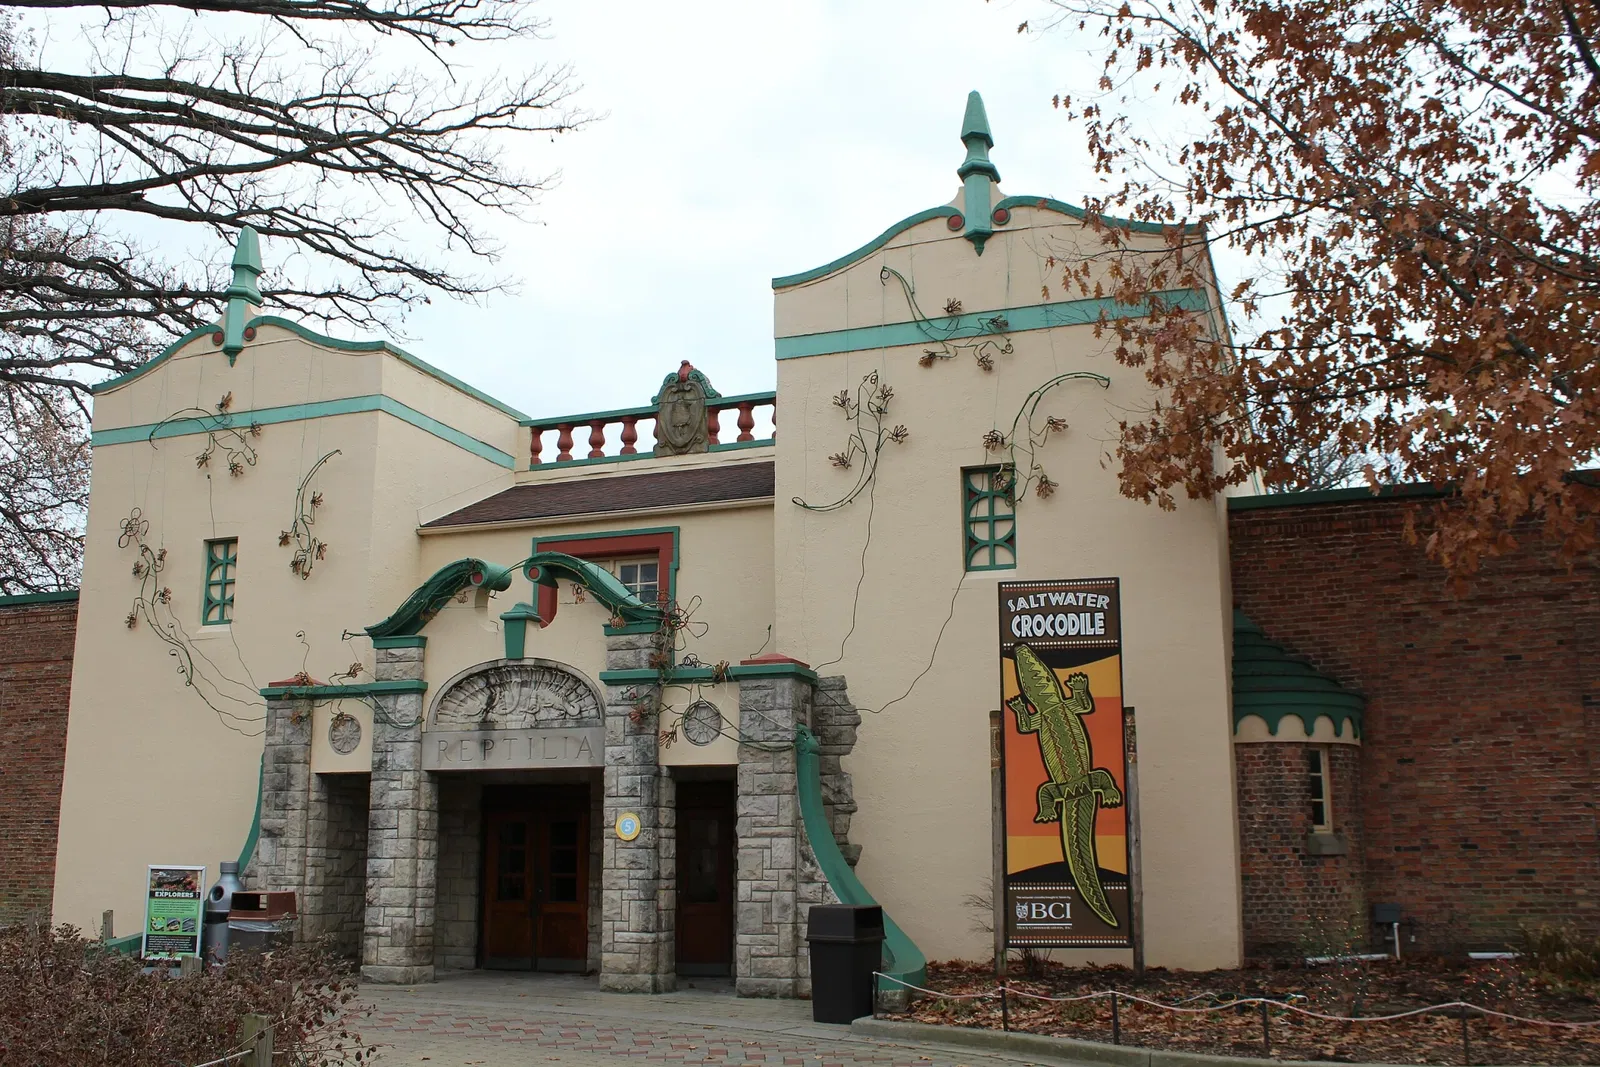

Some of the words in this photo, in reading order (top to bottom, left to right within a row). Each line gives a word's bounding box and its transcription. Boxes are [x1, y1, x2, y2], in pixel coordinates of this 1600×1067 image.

[1007, 592, 1110, 612] SALTWATER
[1011, 612, 1105, 637] CROCODILE
[436, 735, 595, 762] REPTILIA
[624, 821, 632, 832] 5
[1031, 902, 1072, 919] BCI
